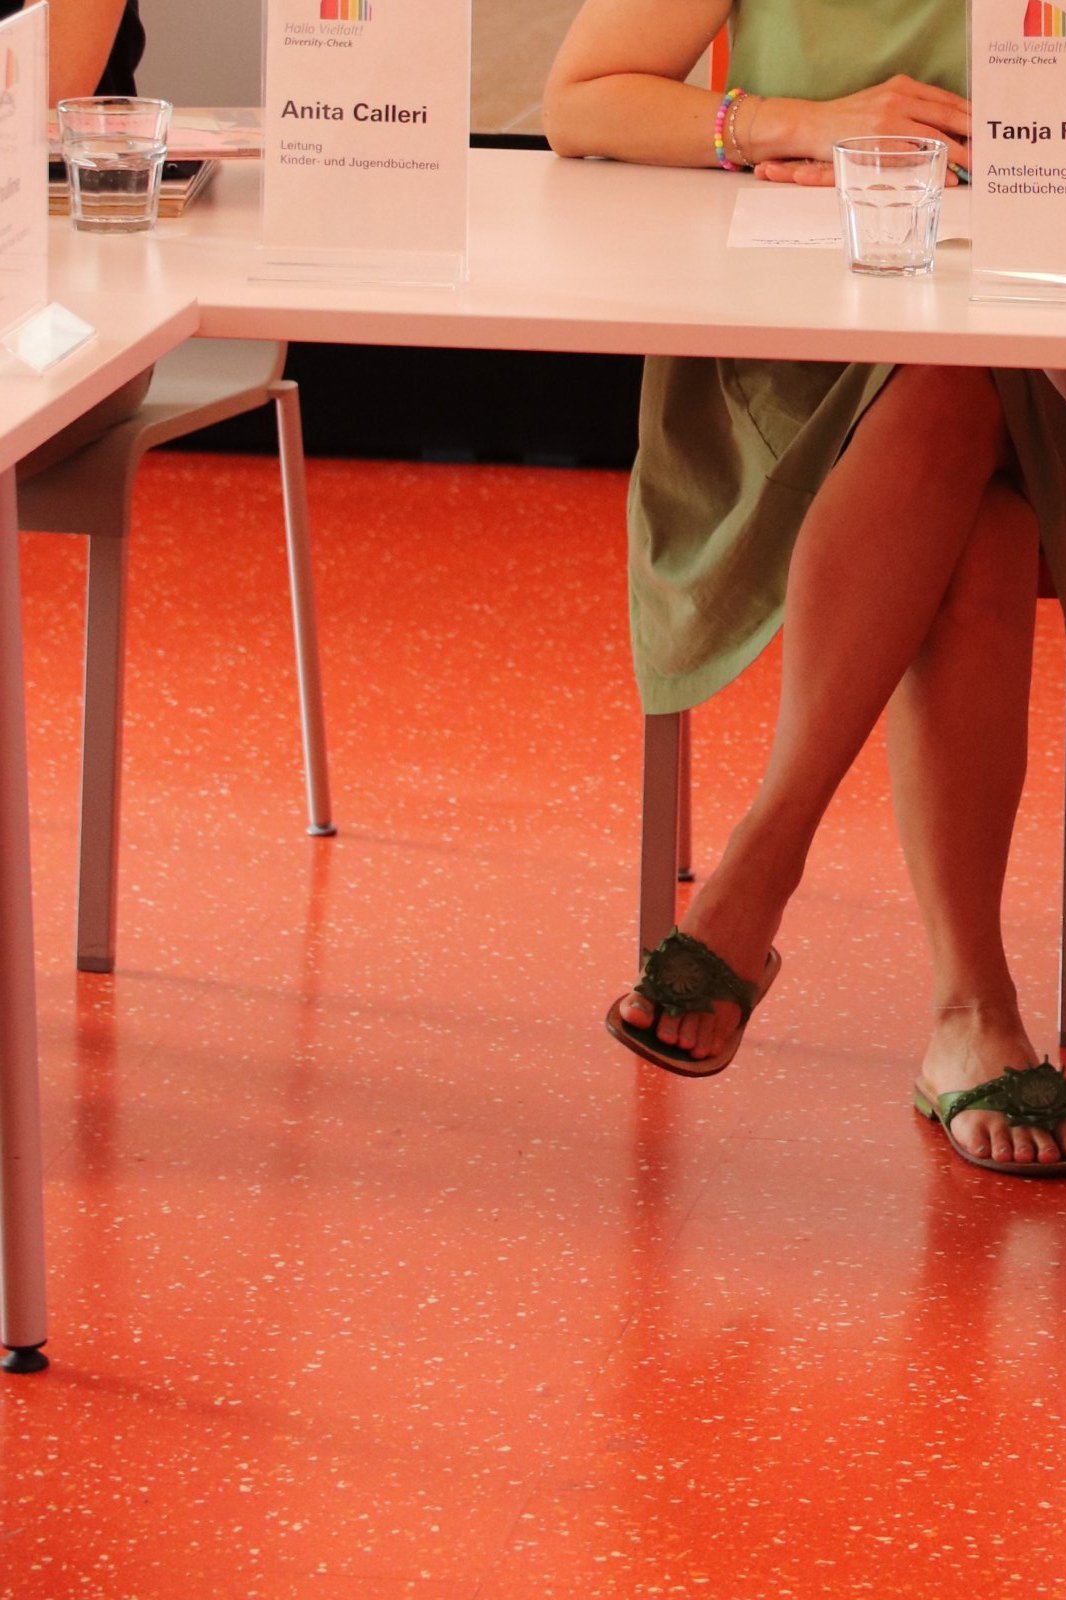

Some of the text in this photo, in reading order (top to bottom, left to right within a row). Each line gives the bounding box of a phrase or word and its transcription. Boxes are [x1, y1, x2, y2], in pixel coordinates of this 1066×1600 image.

[284, 22, 364, 37] Hallo Vielfalt!
[284, 37, 353, 49] Diversity-Check
[988, 40, 1066, 53] Hallo Vielfalt!
[988, 56, 1058, 66] Diversity-Check
[281, 100, 427, 124] Anita Calleri
[987, 121, 1052, 144] Tanja
[280, 140, 323, 154] Leitung
[280, 154, 440, 171] Kinder- und Jugendbücherei
